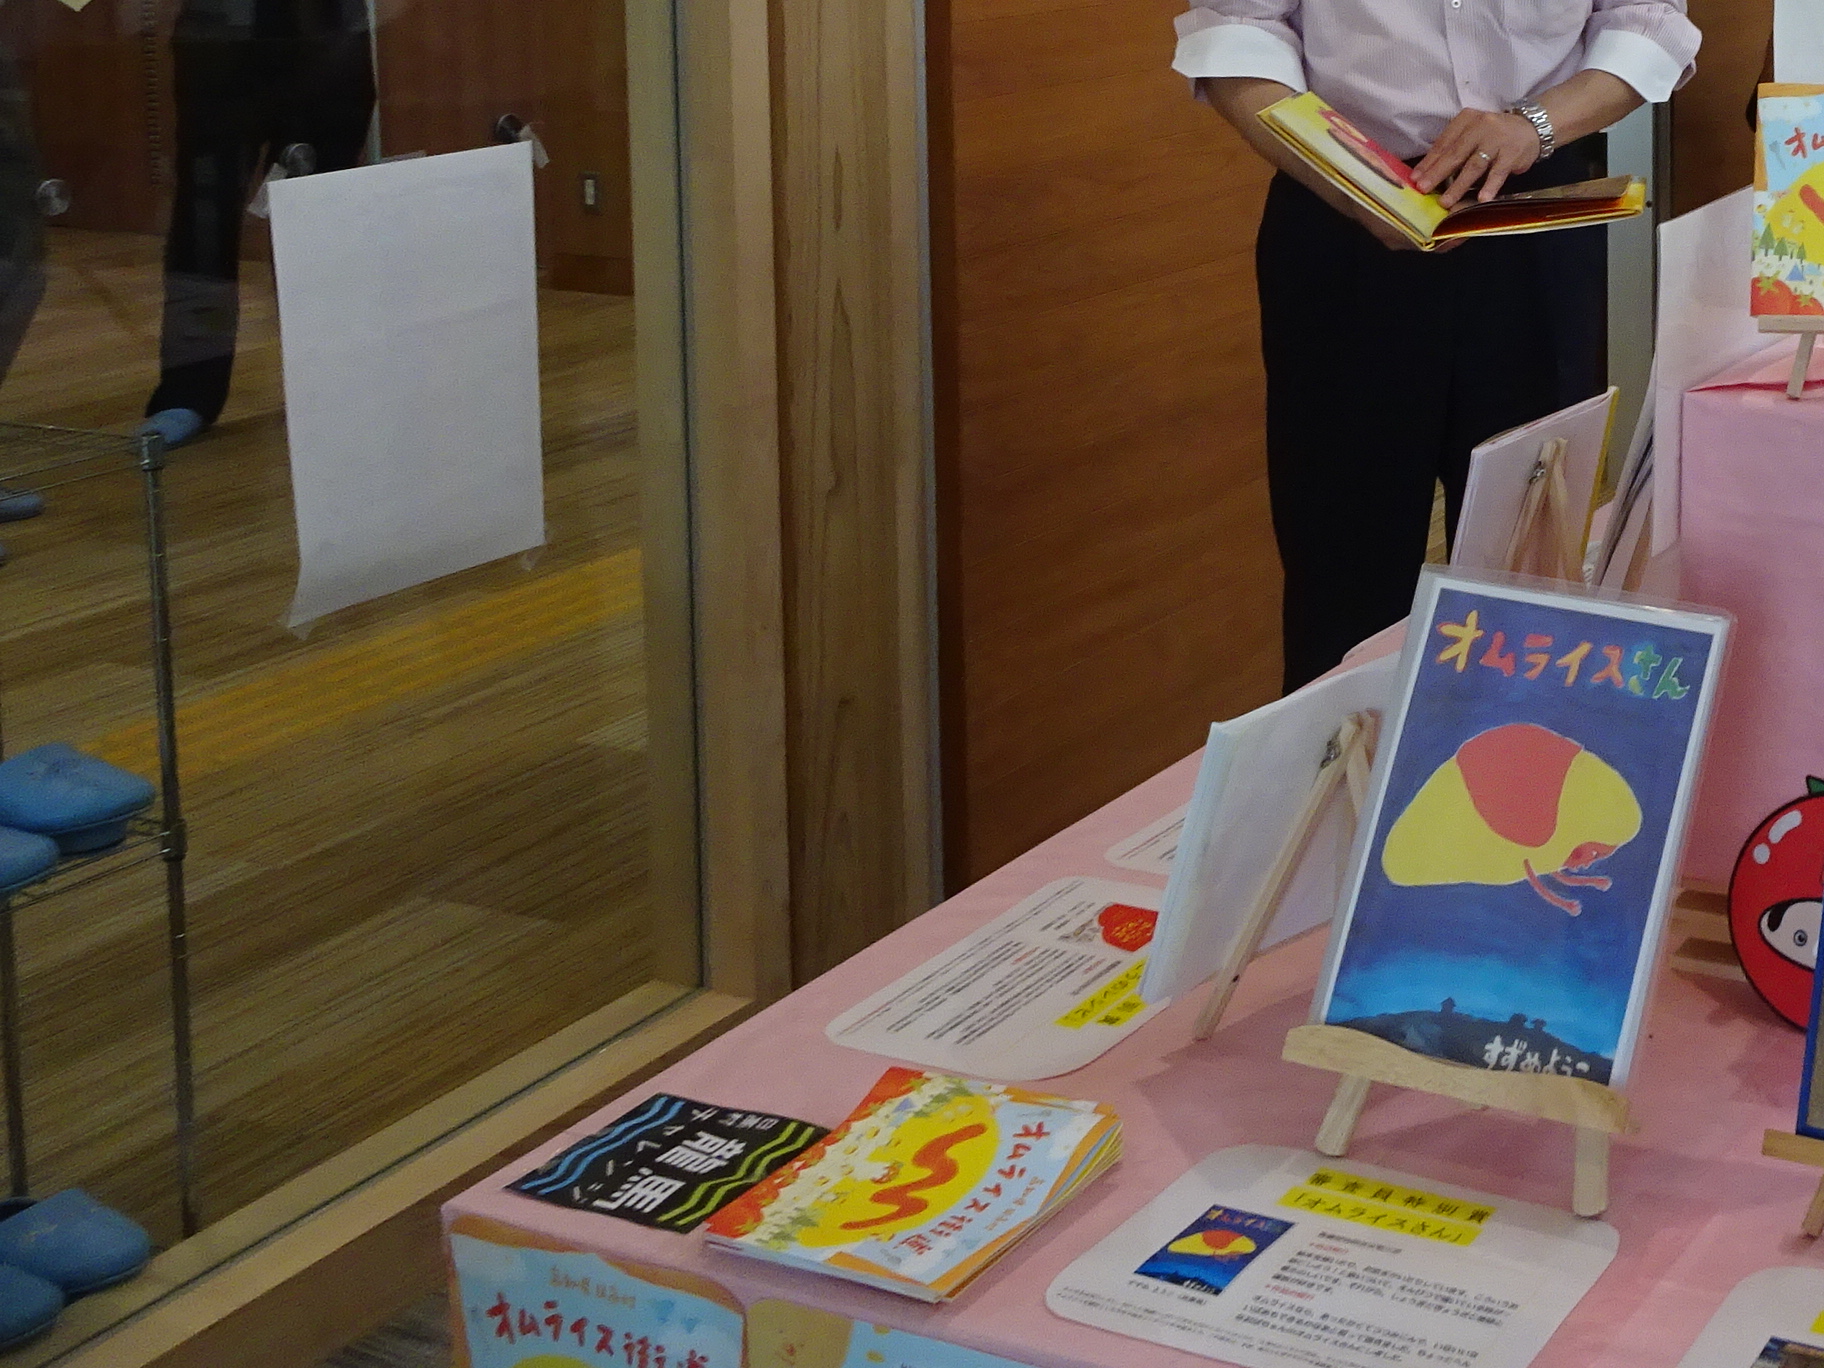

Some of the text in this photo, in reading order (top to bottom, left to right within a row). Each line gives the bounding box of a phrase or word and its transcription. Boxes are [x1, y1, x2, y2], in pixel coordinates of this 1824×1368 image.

[1435, 609, 1691, 700] オムライスさん
[592, 1131, 748, 1214] 龍馬
[1310, 1170, 1492, 1225] 審査員特別賞
